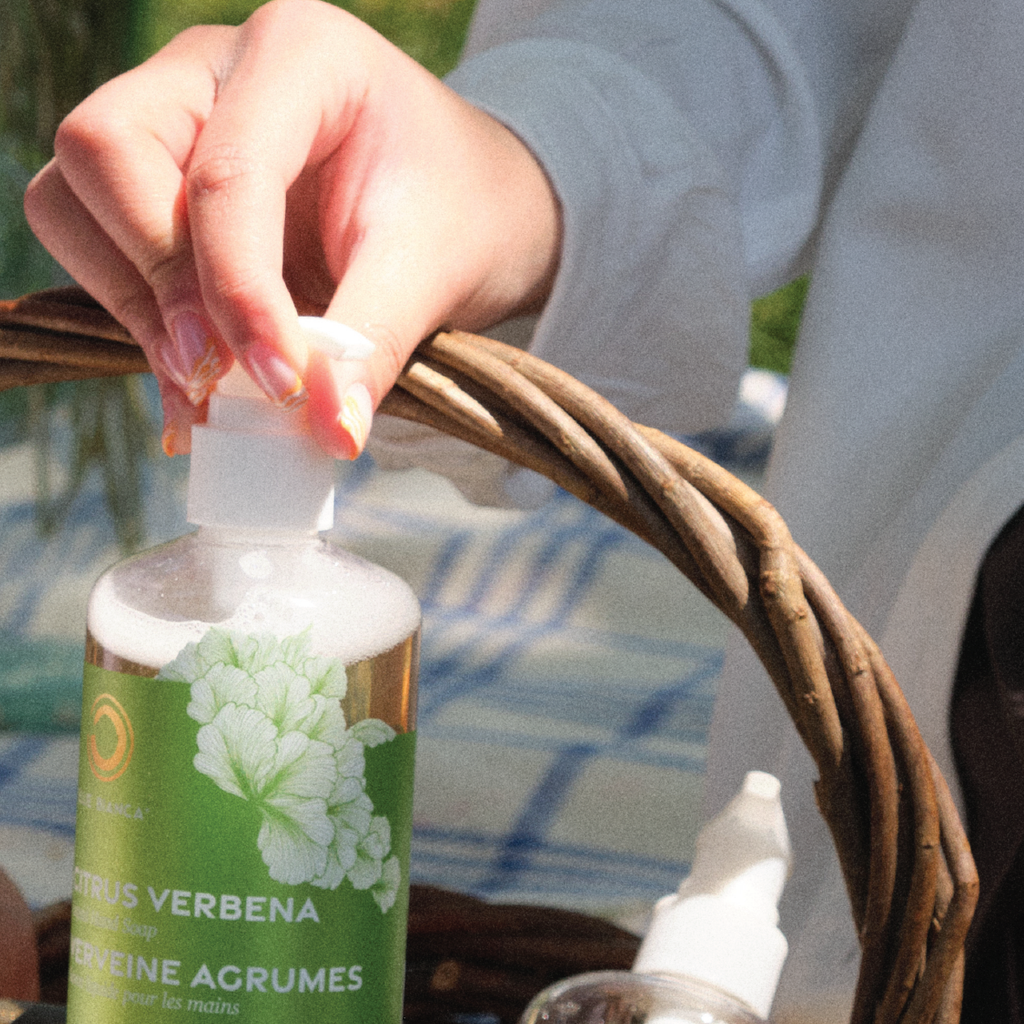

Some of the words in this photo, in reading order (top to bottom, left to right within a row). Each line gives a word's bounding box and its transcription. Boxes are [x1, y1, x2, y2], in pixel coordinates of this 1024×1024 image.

[147, 886, 320, 923] VERBENA
[122, 917, 158, 942] Soap
[190, 963, 363, 993] AGRUMES
[162, 991, 183, 1010] les
[187, 997, 241, 1015] mains
